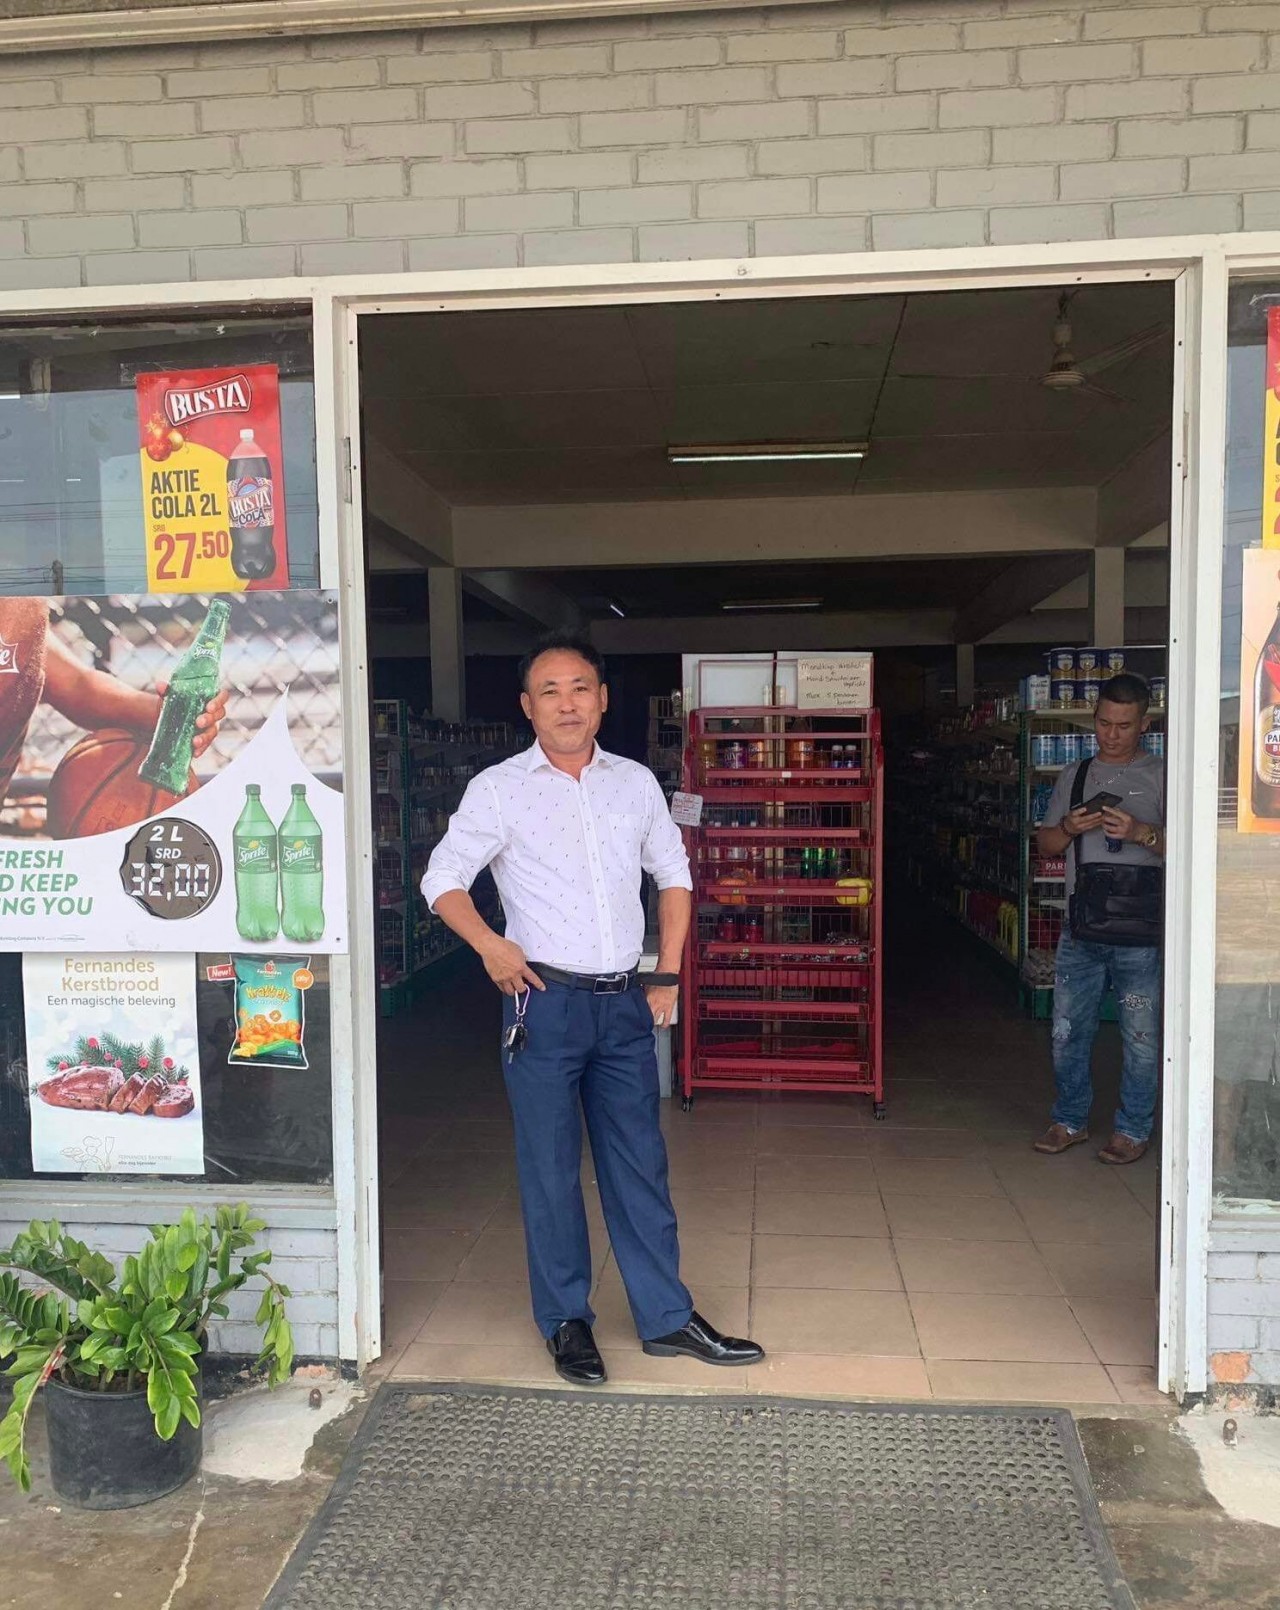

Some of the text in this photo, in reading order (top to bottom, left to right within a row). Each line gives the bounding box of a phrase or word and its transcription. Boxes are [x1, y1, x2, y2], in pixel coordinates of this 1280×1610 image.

[170, 380, 247, 422] BUSTA
[151, 469, 200, 494] AKTIE
[151, 493, 221, 519] COLA 2L
[230, 490, 271, 518] BUSTA
[238, 508, 265, 525] COLA
[154, 530, 229, 580] 27.50
[1267, 734, 1280, 742] PA
[149, 825, 183, 841] 2 L
[155, 848, 182, 859] SRD
[240, 845, 267, 863] Sprite
[284, 845, 312, 863] Sprite
[21, 874, 78, 892] KEEP
[131, 862, 210, 901] 32,00
[0, 897, 93, 915] NG YOU
[64, 958, 155, 973] Fernandes
[211, 967, 231, 977] New!
[61, 977, 159, 992] Kerstbrood
[47, 995, 176, 1008] Een magische beleving
